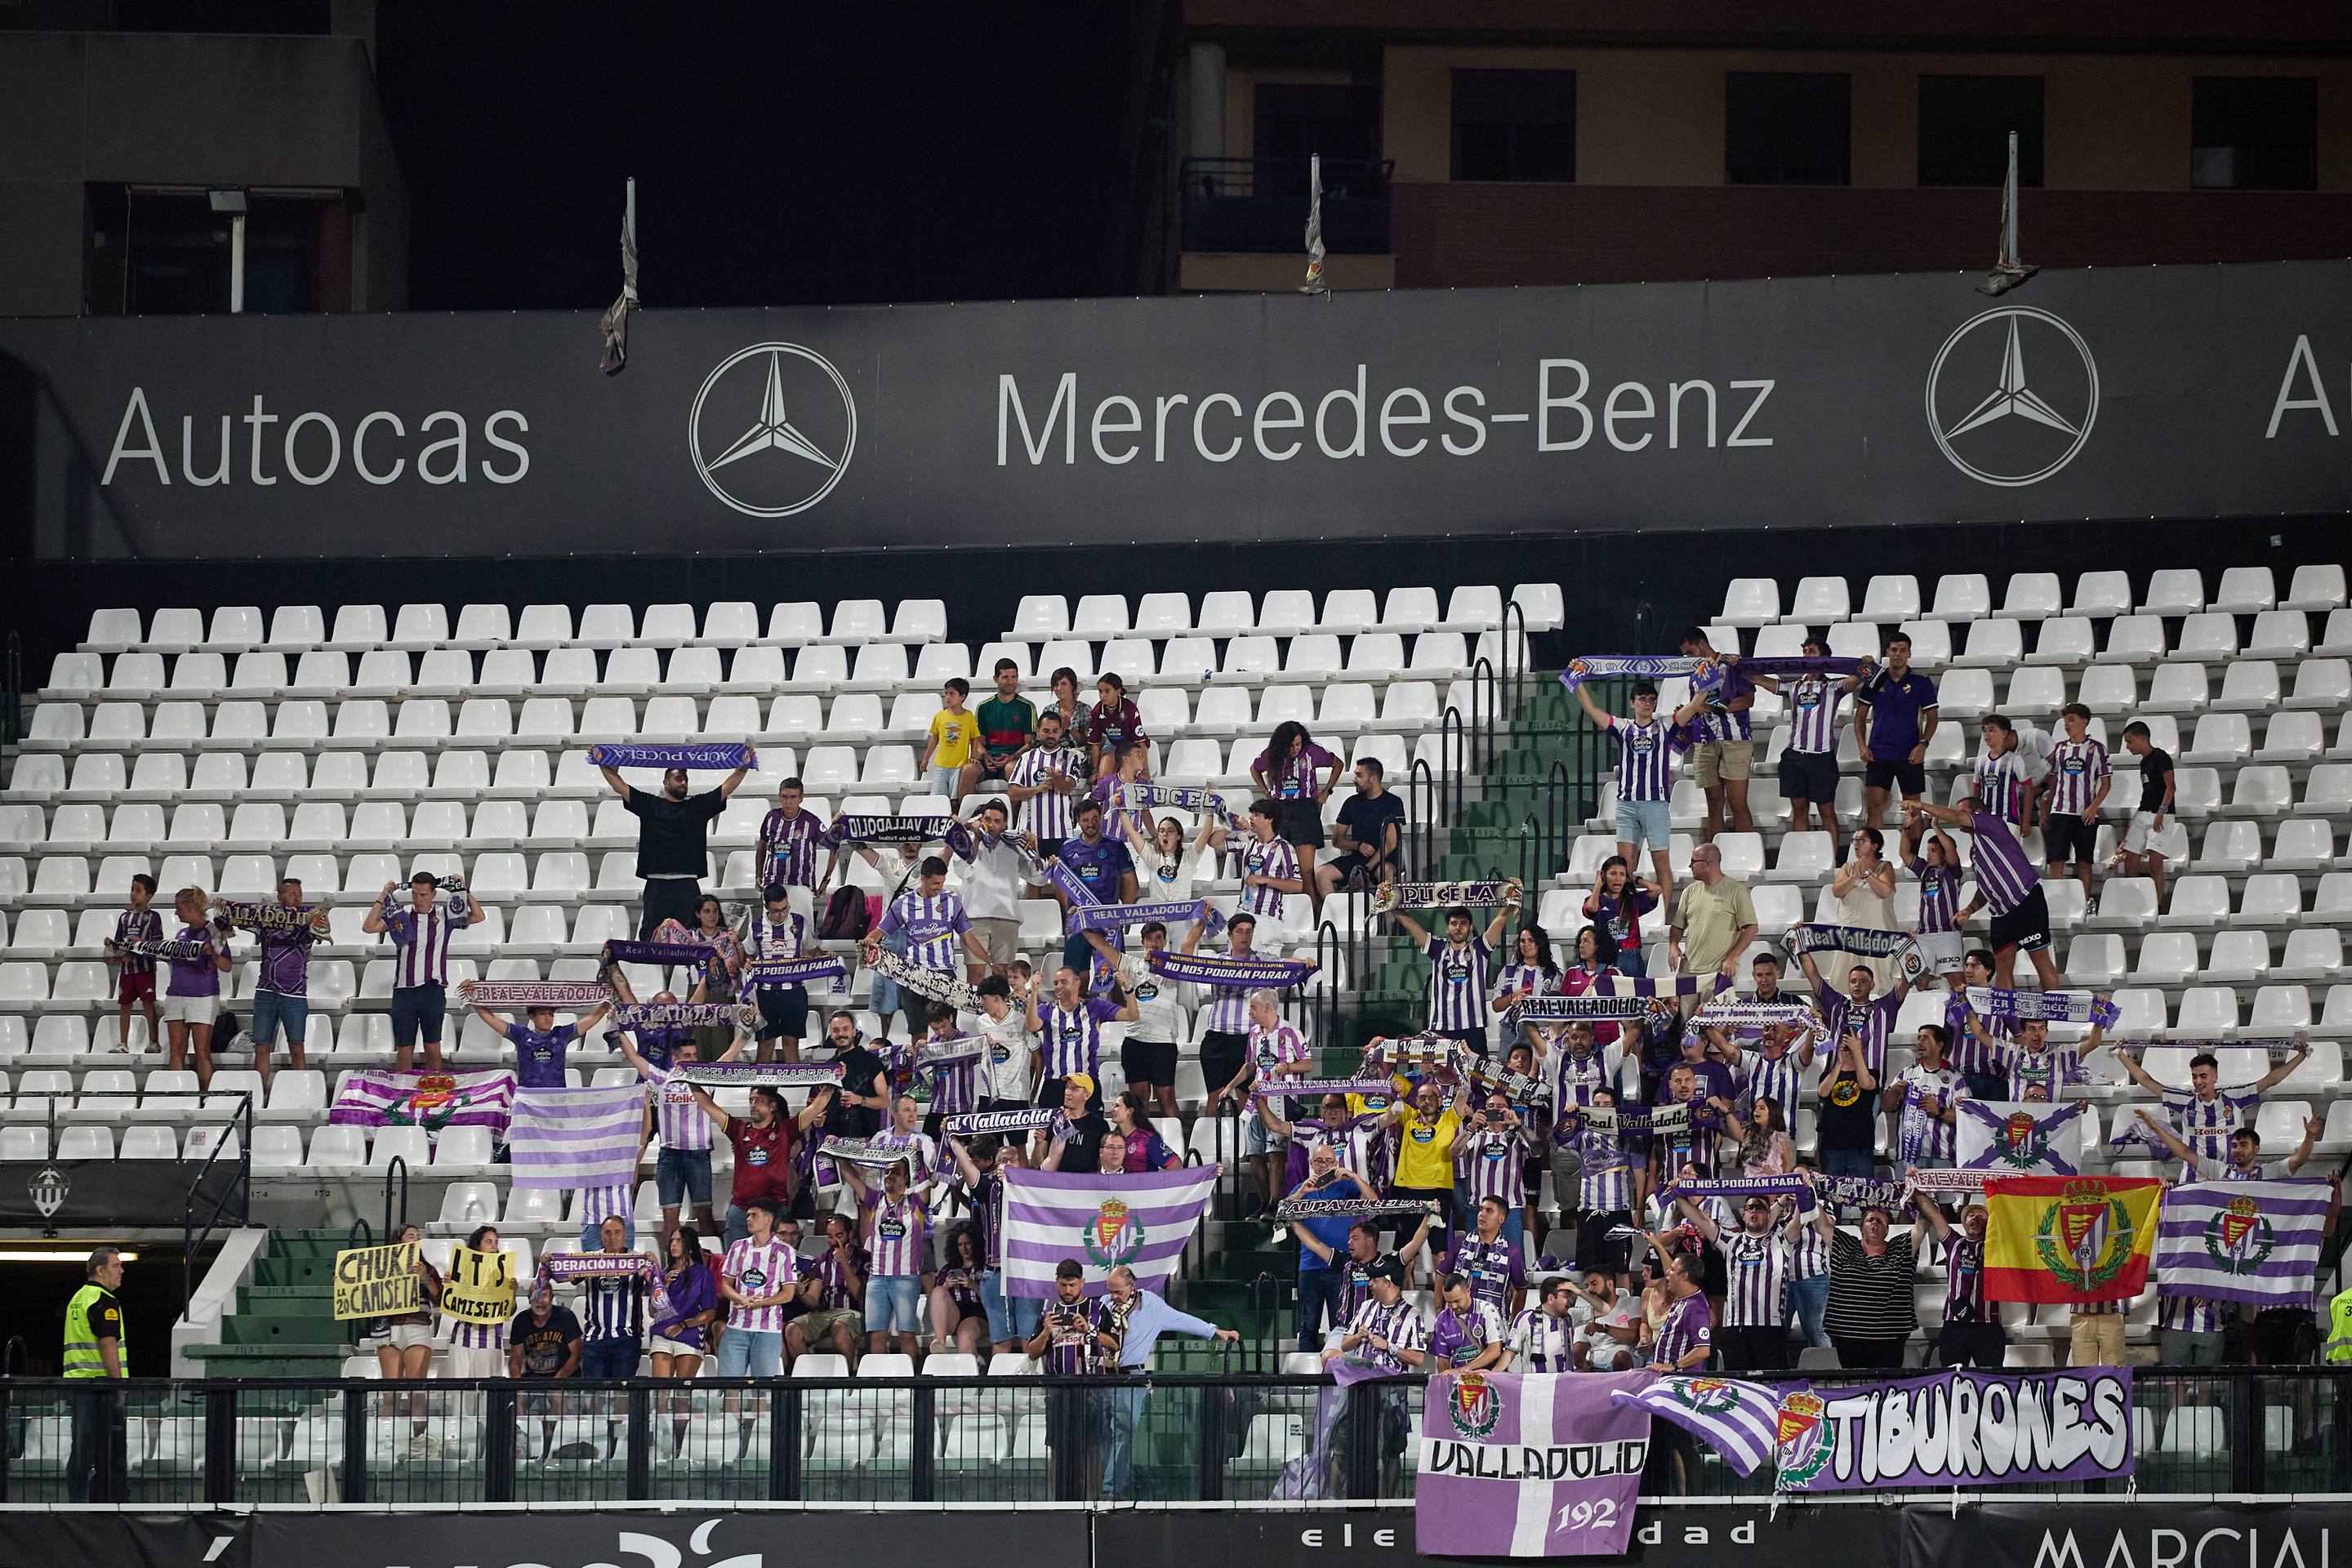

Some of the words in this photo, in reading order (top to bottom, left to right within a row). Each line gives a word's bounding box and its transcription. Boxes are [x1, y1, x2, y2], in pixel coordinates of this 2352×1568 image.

[998, 359, 1775, 466] Mercedes-Benz
[100, 387, 531, 488] Autocas
[614, 749, 684, 761] PUCELA
[690, 749, 733, 762] AUPA
[1134, 786, 1216, 807] PUCEL
[1062, 875, 1081, 899] REAL
[1402, 884, 1498, 904] PUCELA
[1094, 909, 1120, 920] REAL
[1125, 904, 1192, 917] VALLADOLID
[1804, 928, 1835, 946] Real
[1838, 929, 1909, 951] Valladolid
[2019, 933, 2042, 945] NEXO
[137, 940, 200, 958] VALLADOLID
[626, 946, 646, 955] Real
[652, 947, 698, 958] Valladolid
[763, 964, 807, 975] PODRÁN
[1165, 961, 1180, 972] NO
[1182, 964, 1204, 974] NOS
[1205, 968, 1251, 978] PODRÁN
[1252, 969, 1290, 979] PARAR
[483, 982, 516, 1002] REAL
[522, 982, 607, 1002] VALLADOLID
[1988, 989, 2008, 998] Peña
[2012, 991, 2072, 1003] Blanquivioleta
[1521, 999, 1555, 1015] REAL
[1558, 997, 1638, 1014] VALLADOLID
[1972, 996, 2009, 1009] VILLA
[2014, 1001, 2030, 1010] DE
[1700, 1009, 1725, 1019] empre
[1728, 1009, 1758, 1018] Juntos,
[1762, 1009, 1794, 1019] siempre
[1376, 1040, 1397, 1051] eal
[1400, 1039, 1460, 1052] Valladolid
[685, 1066, 758, 1082] PUCELANOS
[777, 1067, 832, 1082] MADRID
[1479, 1060, 1538, 1092] Valladolid
[2017, 1069, 2050, 1080] Parquesol
[1353, 1079, 1392, 1088] VALLADOL
[664, 1091, 697, 1104] Helio
[947, 1116, 962, 1132] al
[964, 1108, 1052, 1133] Valladolid
[1579, 1112, 1615, 1129] Real
[1618, 1109, 1692, 1129] Valladolid
[2194, 1127, 2230, 1136] Helios
[822, 1138, 866, 1156] ELANOS
[1678, 1178, 1695, 1189] NO
[1696, 1178, 1721, 1189] NOS
[1722, 1174, 1770, 1188] PODRÁN
[1771, 1175, 1803, 1187] PARA
[1911, 1172, 1937, 1185] REAL
[1285, 1200, 1340, 1214] AUPA
[338, 1242, 415, 1285] CHUKI
[550, 1258, 617, 1272] EDERACIÓN
[618, 1258, 634, 1269] DE
[336, 1288, 346, 1297] LA
[336, 1298, 350, 1315] 20
[350, 1276, 420, 1314] CAMISETA
[443, 1287, 510, 1319] CAMISETA?
[1824, 1374, 2130, 1483] TIBURONES
[1432, 1439, 1645, 1480] VALLADOLID
[1555, 1501, 1625, 1534] 192
